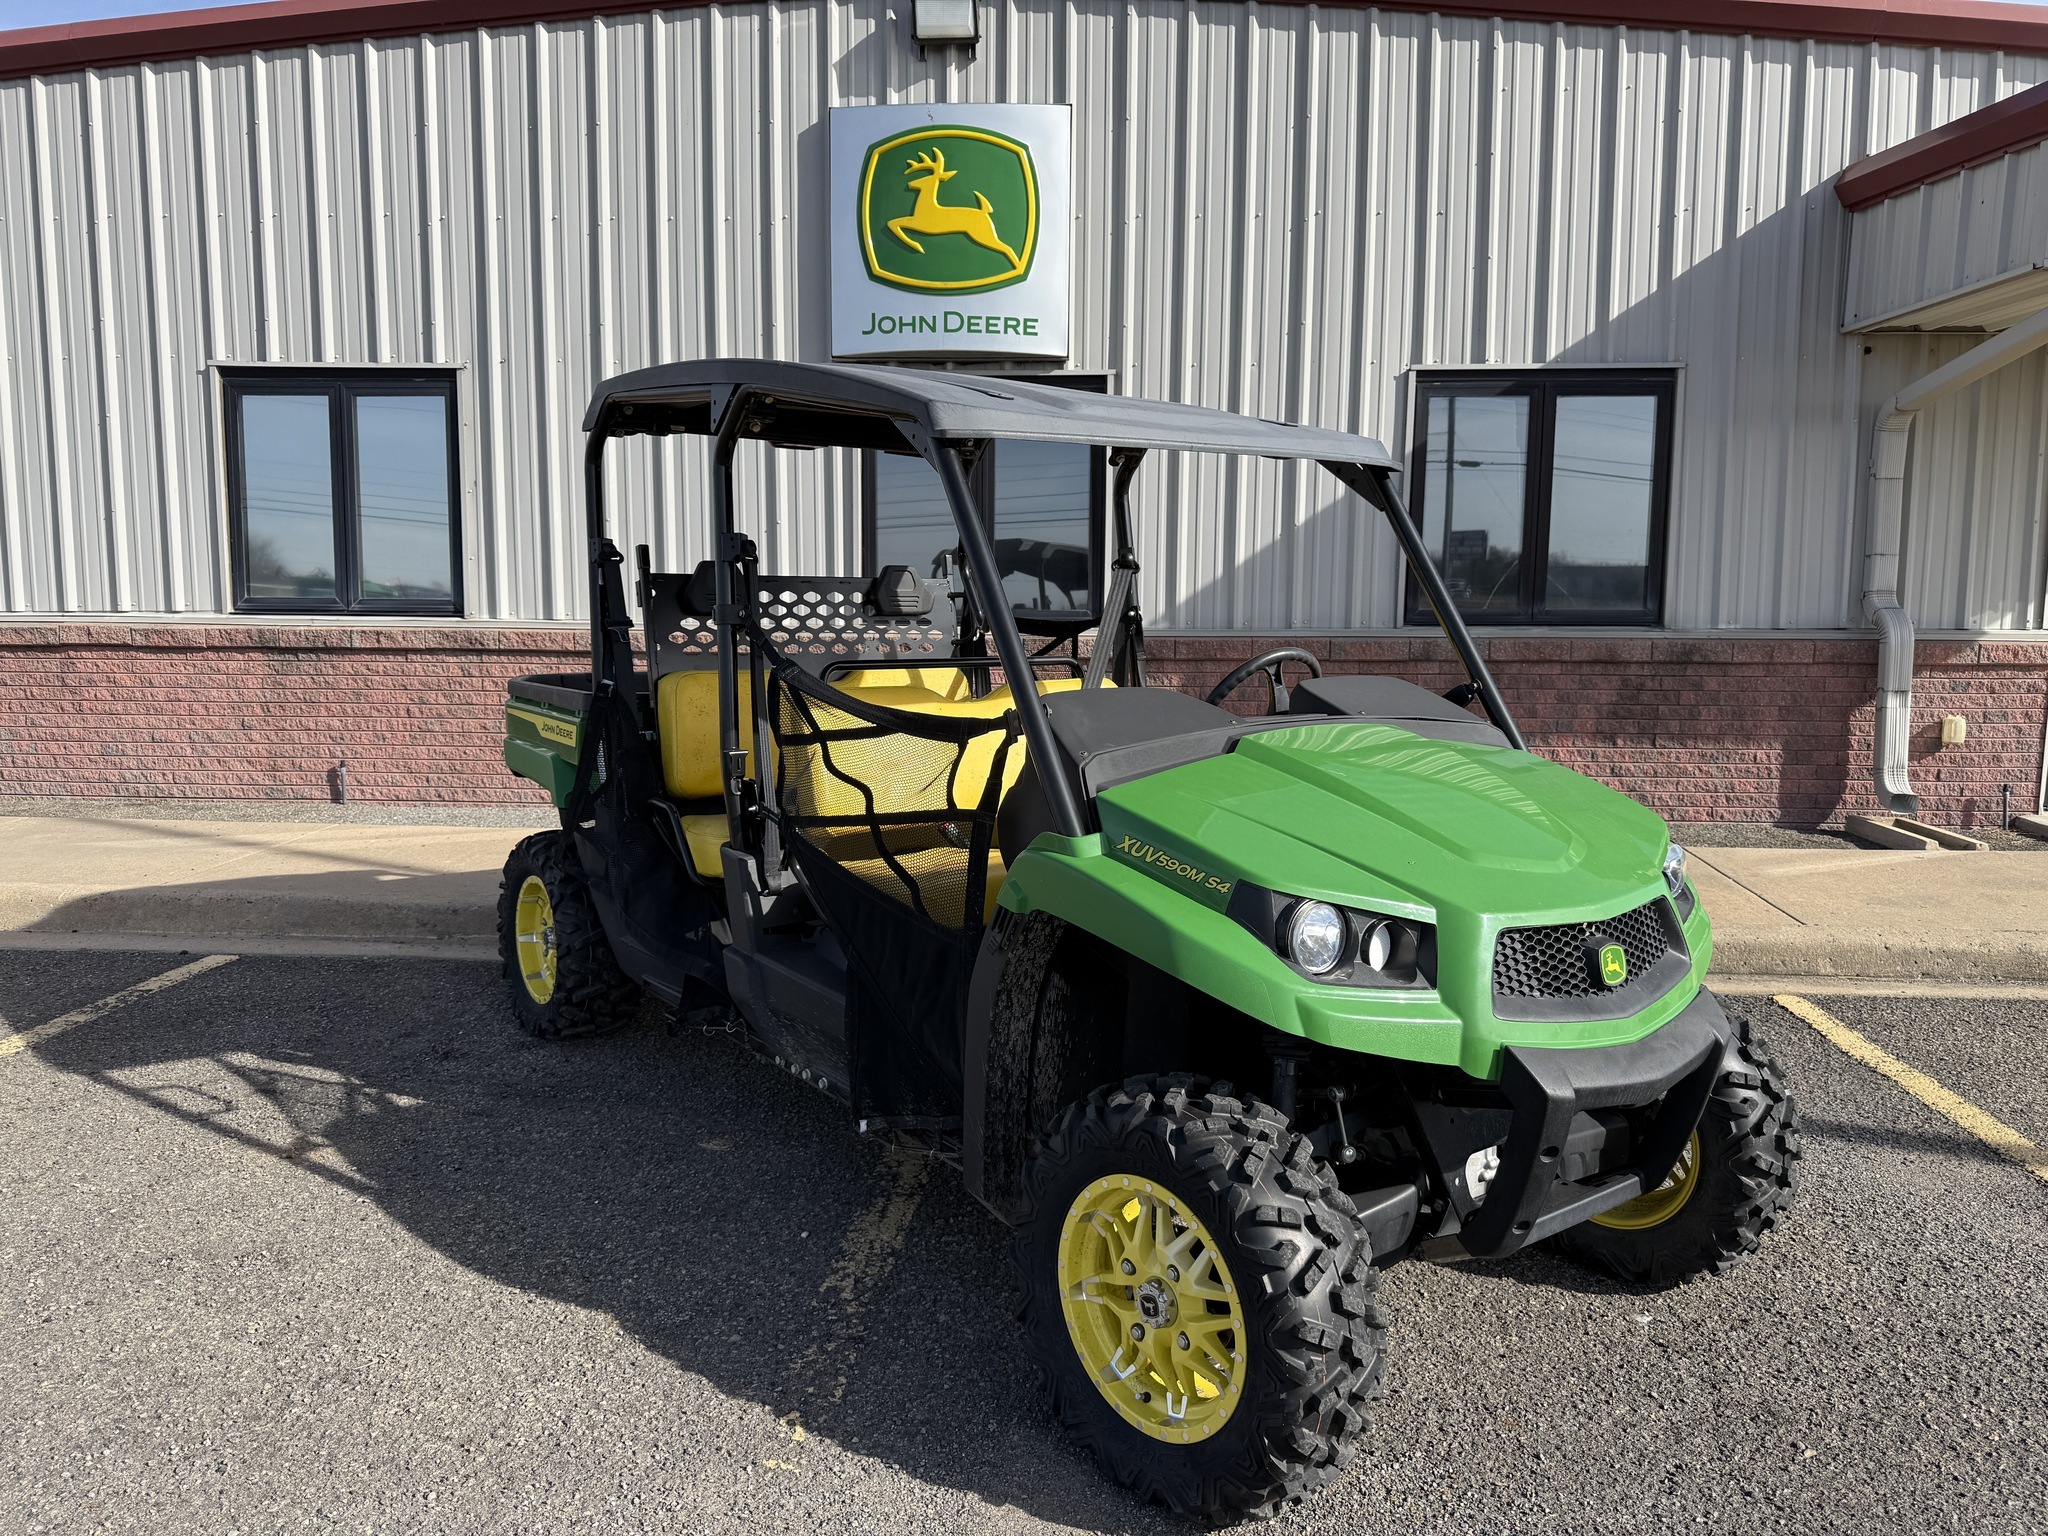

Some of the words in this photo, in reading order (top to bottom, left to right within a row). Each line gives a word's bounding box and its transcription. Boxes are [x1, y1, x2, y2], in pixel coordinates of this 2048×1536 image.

[862, 312, 936, 335] JOHN
[943, 310, 1039, 336] DEERE
[541, 721, 555, 734] JOHN
[555, 725, 574, 740] DEERE
[1115, 834, 1206, 883] XUV590M
[1203, 876, 1233, 894] S4
